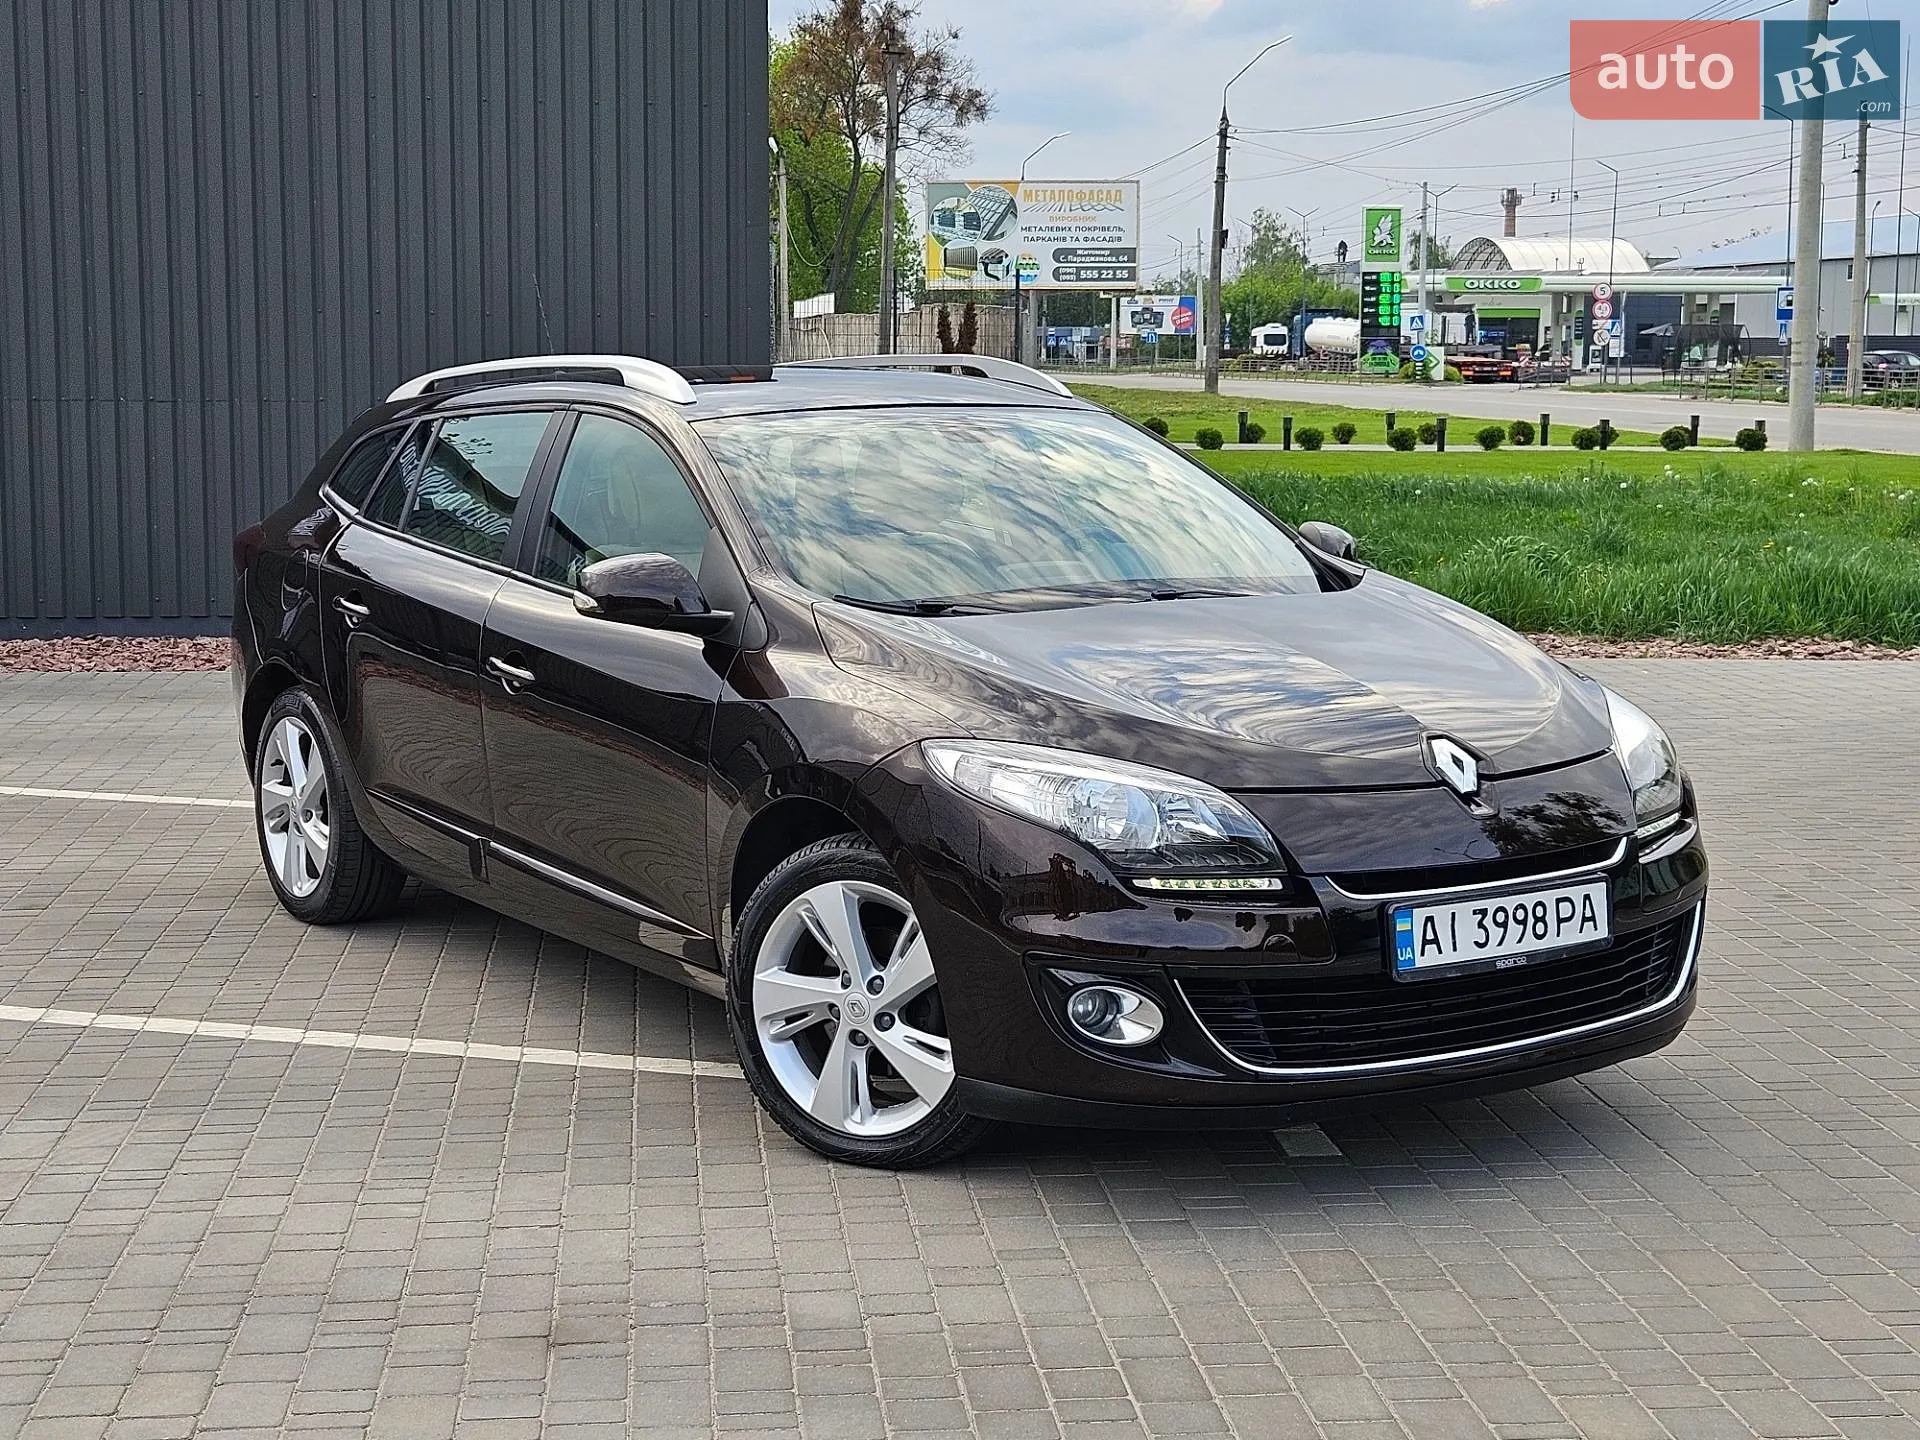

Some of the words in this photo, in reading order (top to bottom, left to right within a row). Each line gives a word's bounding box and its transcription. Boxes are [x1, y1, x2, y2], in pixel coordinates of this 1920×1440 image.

[1023, 189, 1123, 204] МЕТАЛОФАСАД
[1049, 215, 1097, 223] ВИРОБНИК
[1020, 225, 1072, 233] МЕТАЛЕВИХ
[1074, 225, 1126, 233] ПОКРІВЕЛЬ,
[1082, 236, 1123, 244] ФАСАДІВ
[1079, 270, 1099, 279] 555
[1100, 270, 1114, 279] 22
[1115, 270, 1129, 279] 55
[1464, 279, 1521, 290] OKKO
[1599, 286, 1606, 296] 5
[1397, 946, 1414, 961] UA
[1495, 955, 1527, 969] sparco
